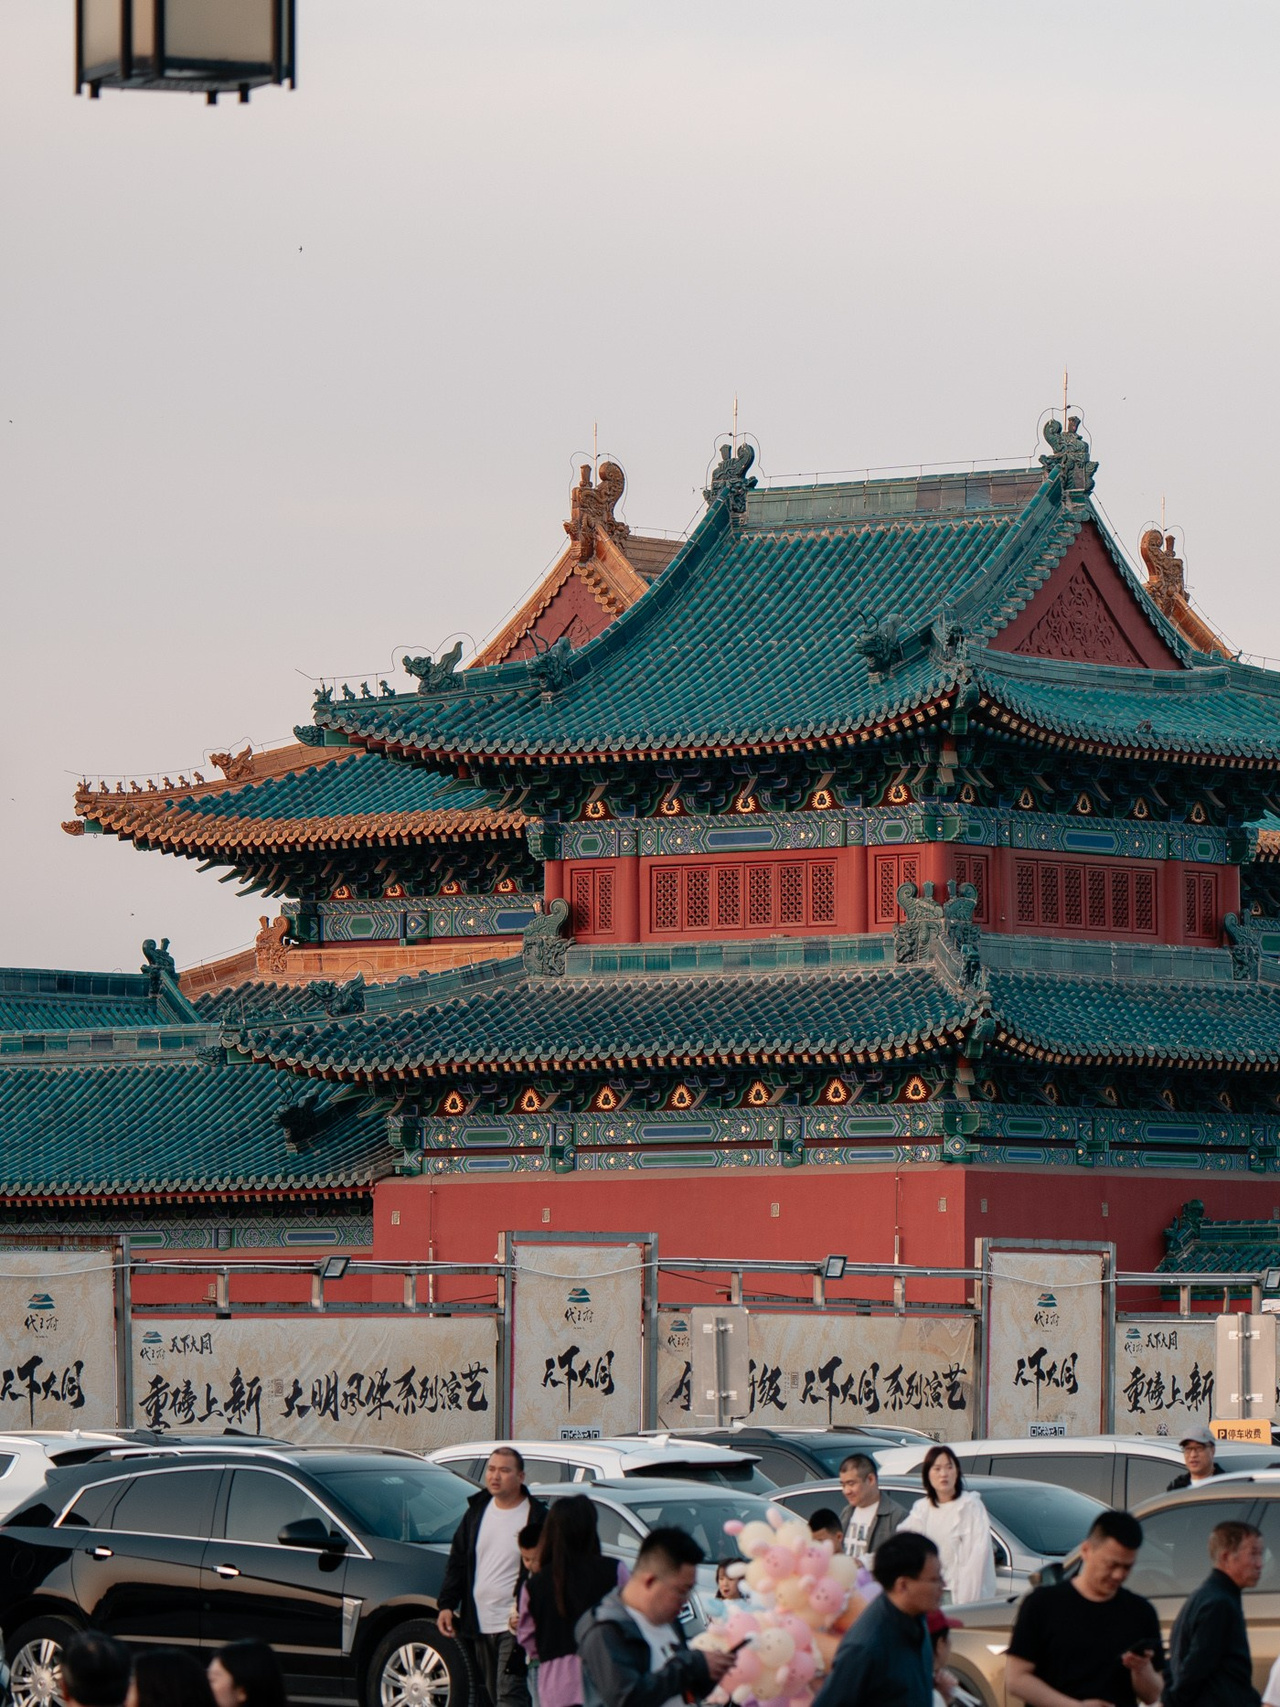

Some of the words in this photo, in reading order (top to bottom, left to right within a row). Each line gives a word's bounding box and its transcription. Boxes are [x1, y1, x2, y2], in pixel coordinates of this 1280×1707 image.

[24, 1313, 59, 1333] 代王府
[564, 1306, 594, 1324] 代王府
[1034, 1311, 1059, 1327] 代王府
[140, 1346, 165, 1361] 代王府
[169, 1332, 213, 1356] 天下大同
[541, 1345, 615, 1413] 天下大同
[1013, 1347, 1079, 1410] 天下大同
[0, 1355, 85, 1428] 天下大同
[139, 1367, 262, 1434] 重磅上新
[1123, 1362, 1214, 1422] 重磅上新
[1228, 1428, 1262, 1439] 停车收费
